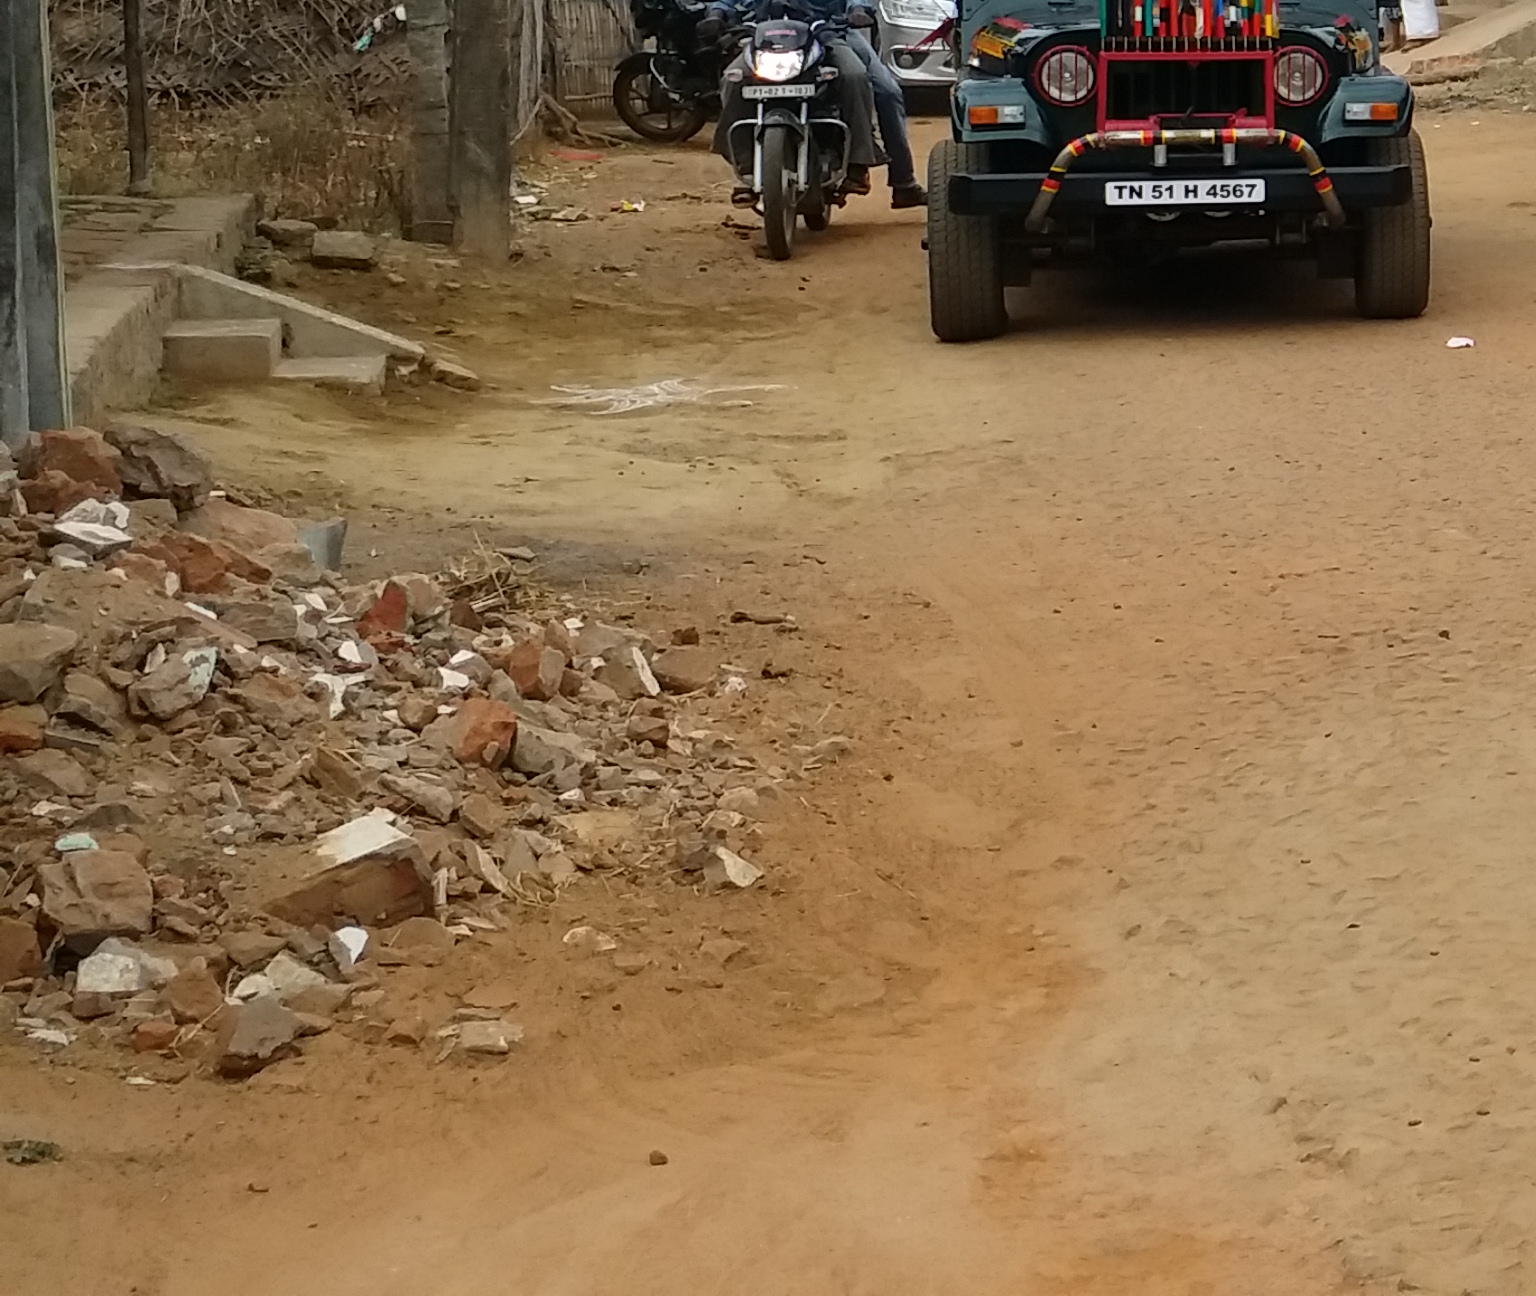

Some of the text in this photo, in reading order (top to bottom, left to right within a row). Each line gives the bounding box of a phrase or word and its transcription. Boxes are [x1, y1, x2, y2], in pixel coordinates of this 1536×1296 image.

[1114, 183, 1258, 200] TN 51 H 4567
